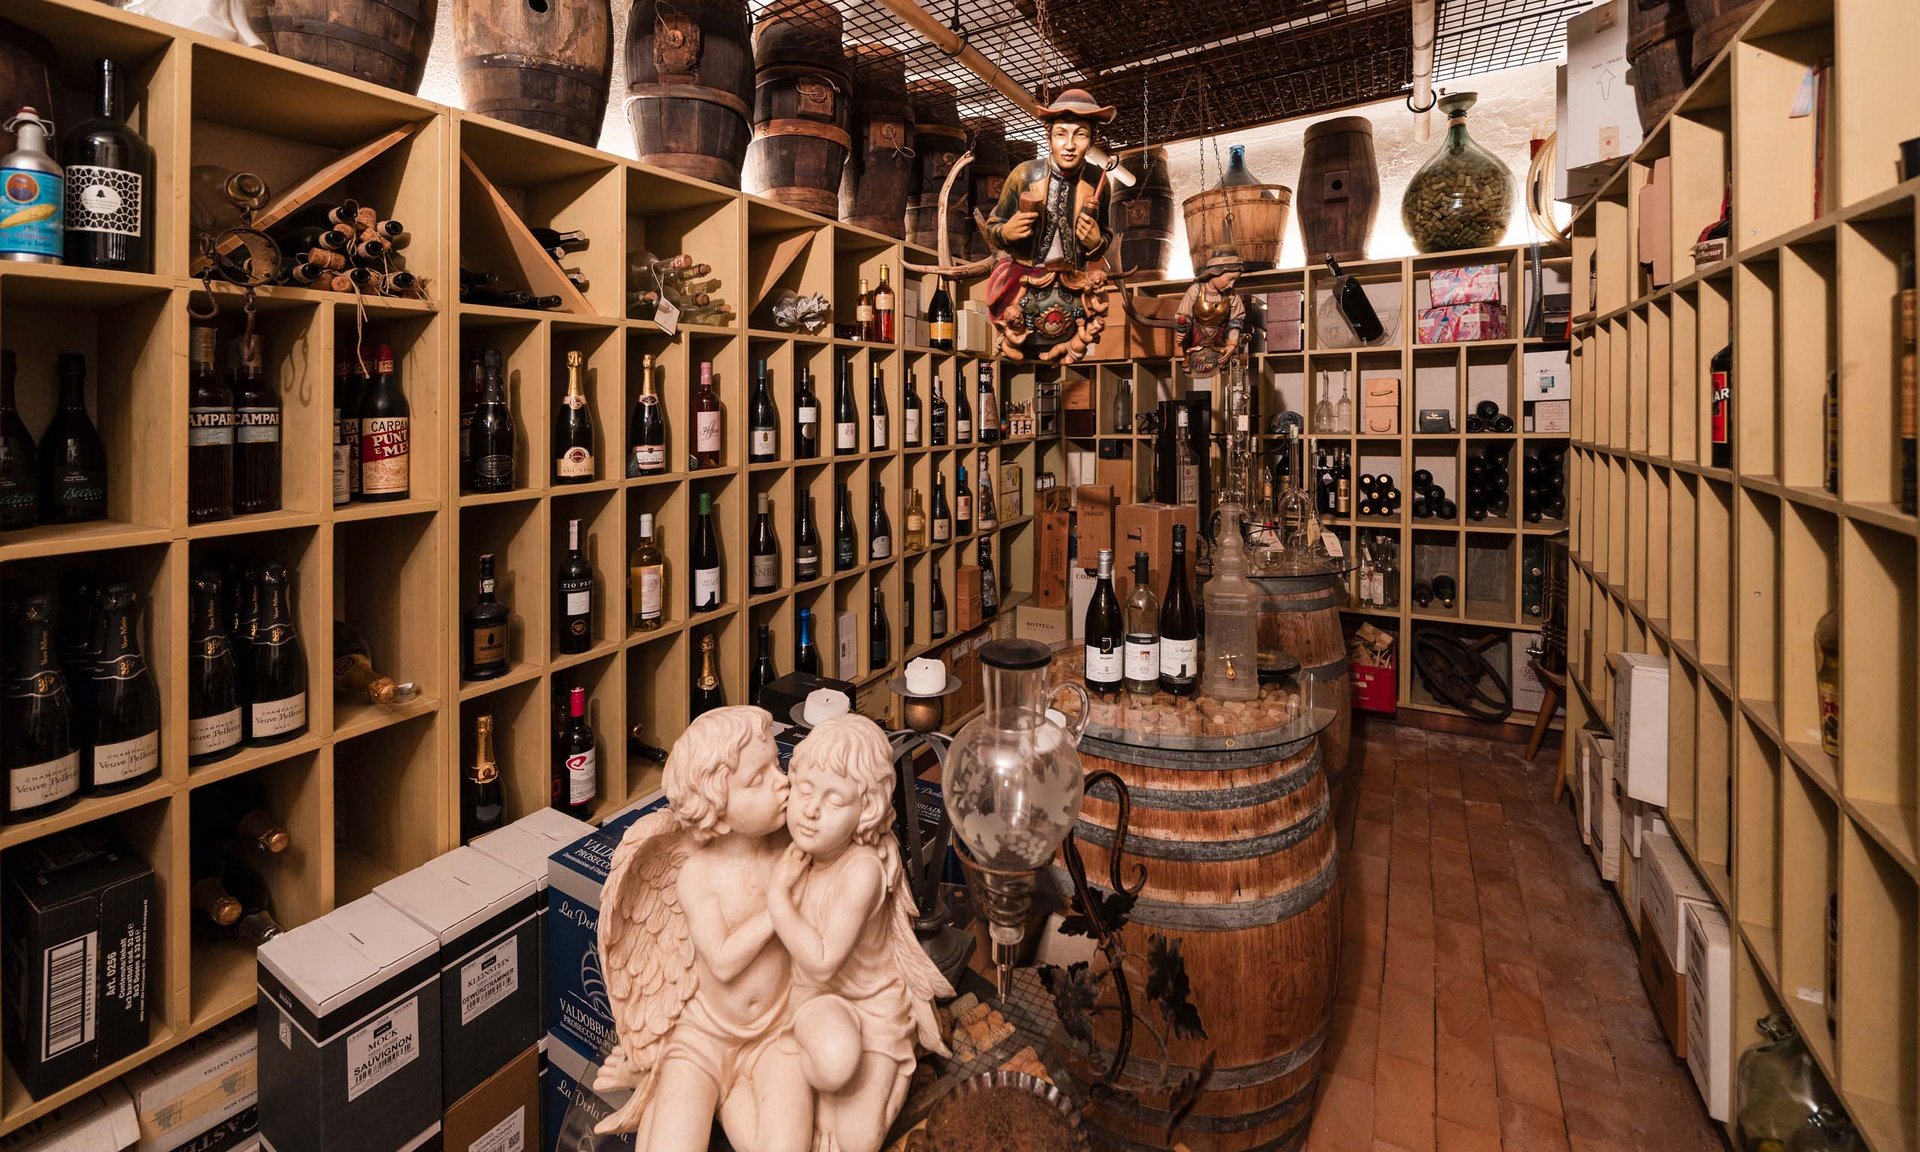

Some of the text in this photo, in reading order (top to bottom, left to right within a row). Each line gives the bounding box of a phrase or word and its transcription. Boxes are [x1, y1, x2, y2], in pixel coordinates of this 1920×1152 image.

[99, 759, 127, 770] Veuve
[15, 781, 48, 794] Veuve
[558, 901, 598, 933] La Perl
[127, 937, 134, 947] 33
[133, 943, 141, 953] 33
[106, 951, 117, 997] Art. 0256
[118, 937, 128, 999] Contenuto/Inhalt
[133, 960, 141, 982] Dosen
[467, 956, 510, 987] KLEINSTEIN
[462, 967, 514, 1005] GEWÜRZTRAMINER
[559, 997, 619, 1045] VALDOBBIAD
[563, 1013, 596, 1042] PROSECCO
[354, 1033, 412, 1076] SAUVIGNON
[367, 1028, 398, 1052] MOCK
[203, 1059, 229, 1075] NATURA
[556, 1079, 601, 1122] La Perla
